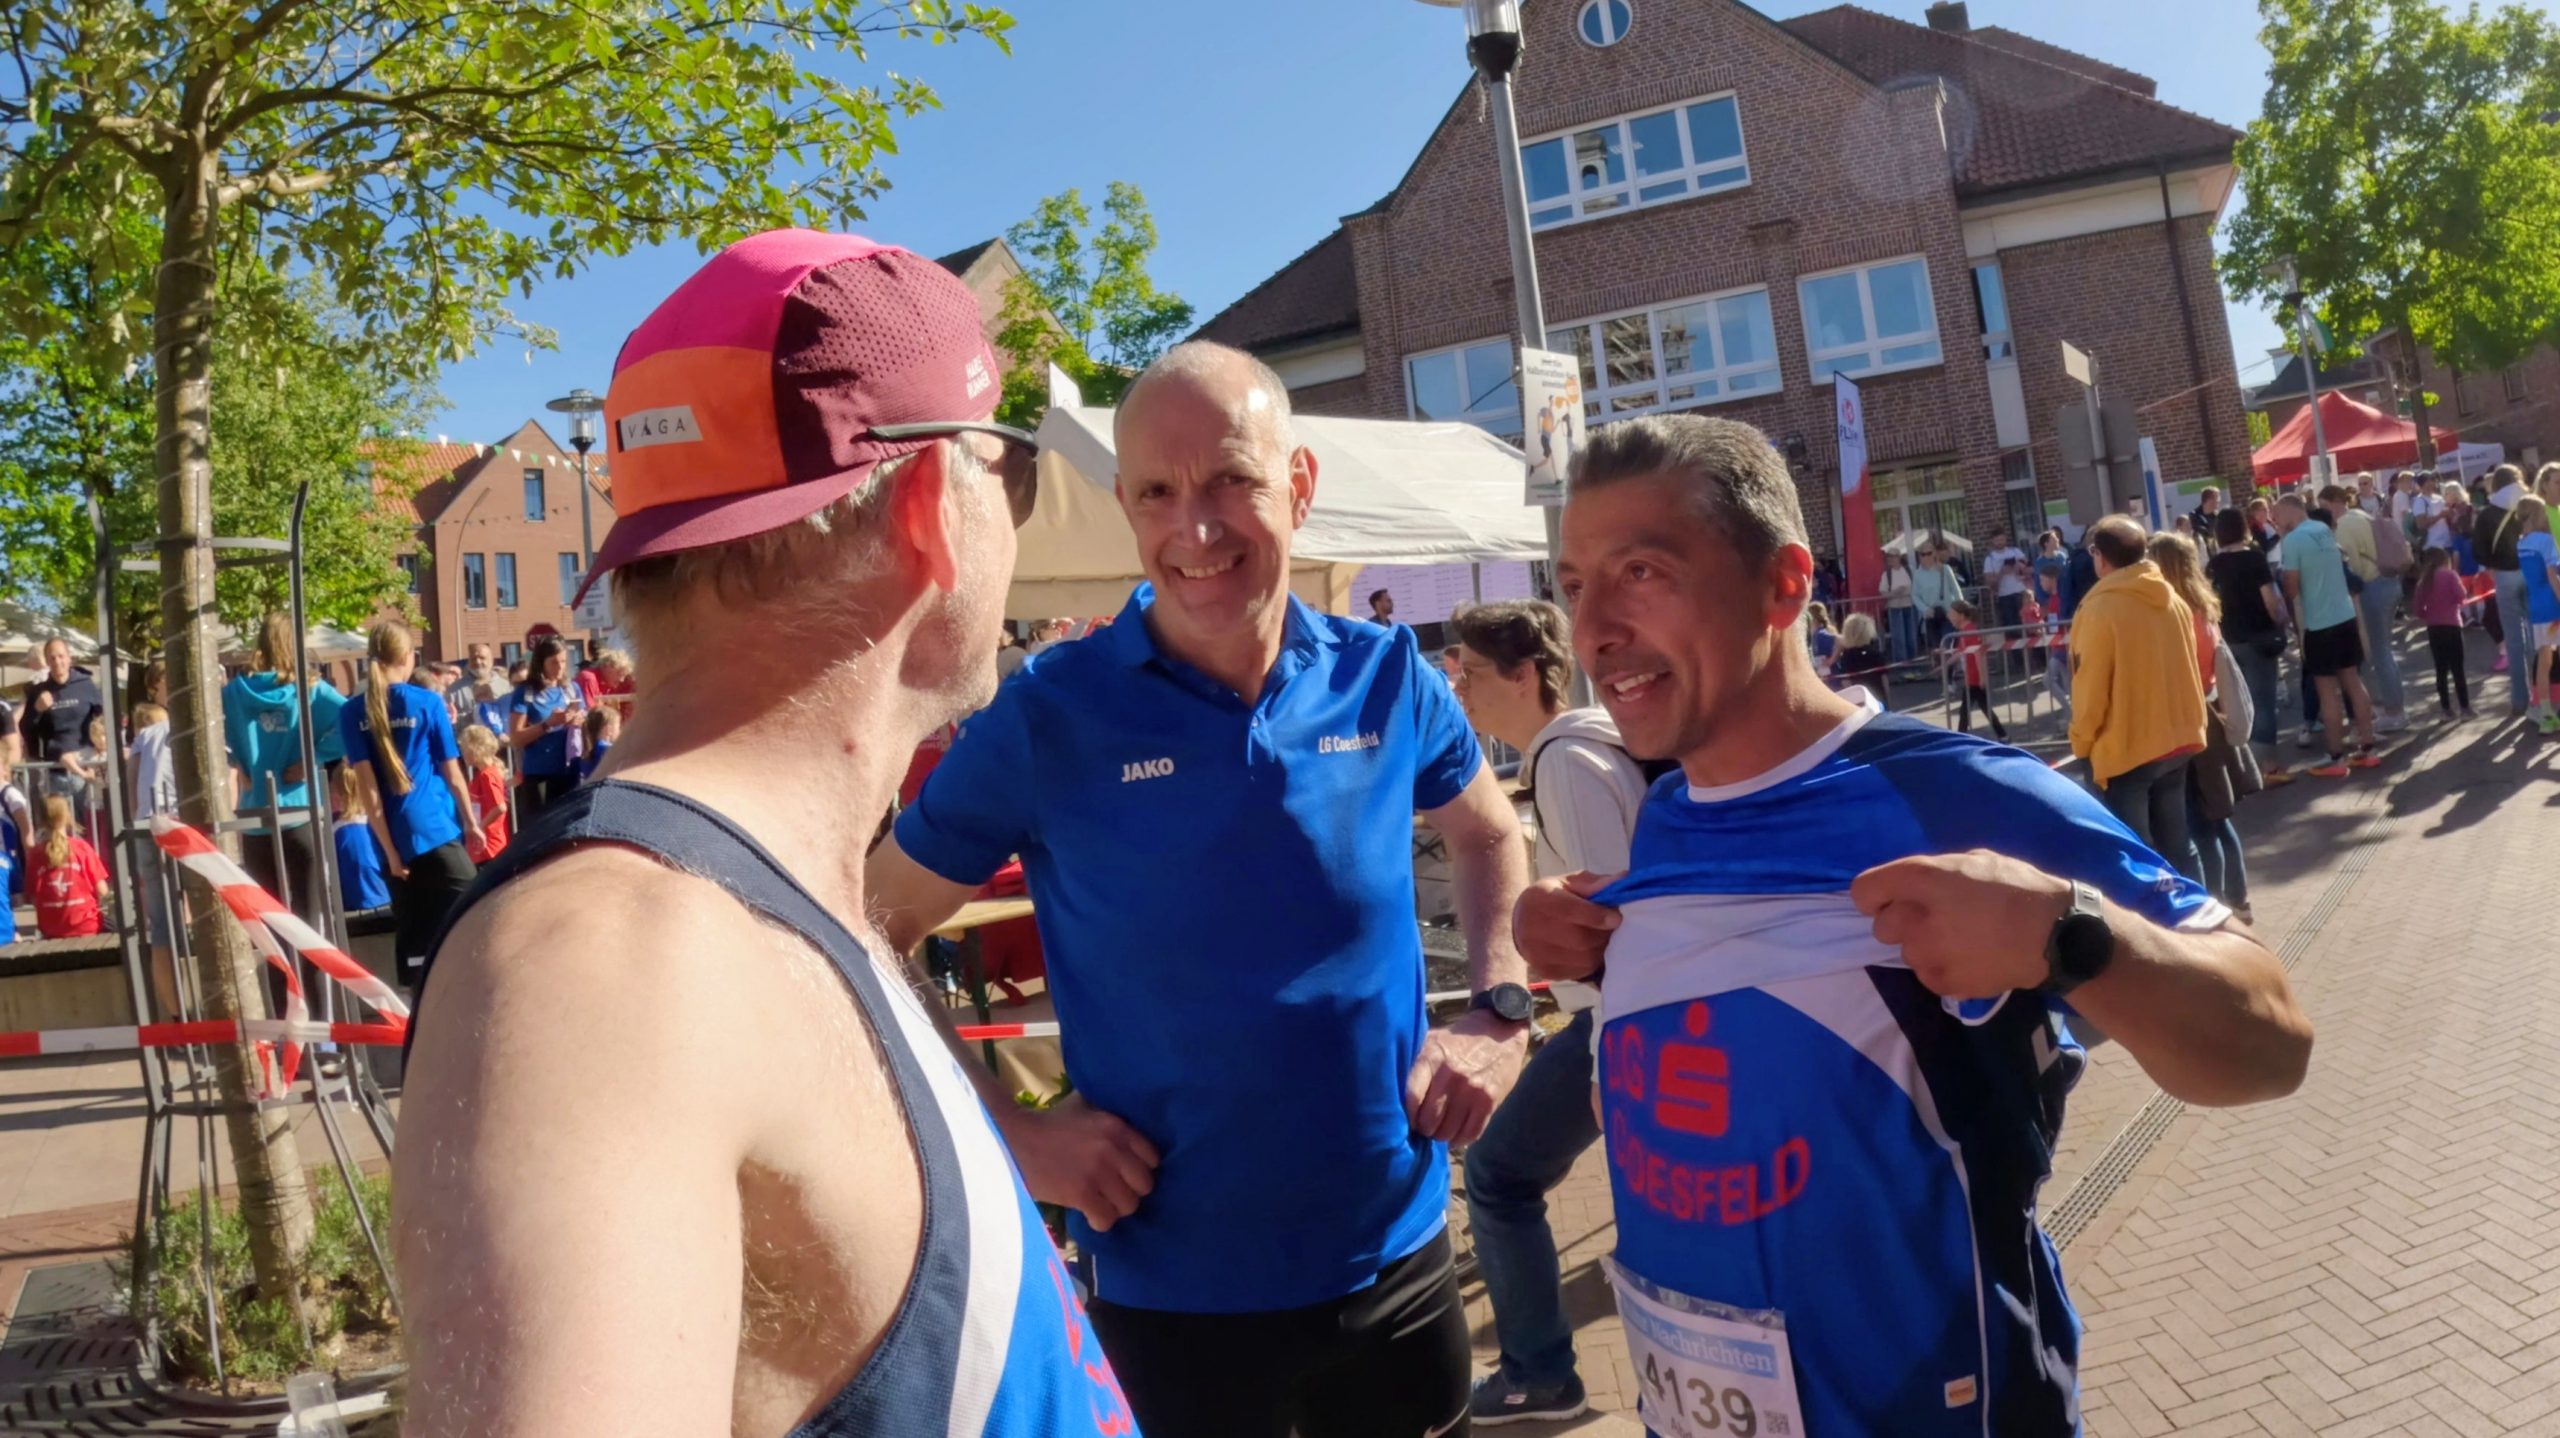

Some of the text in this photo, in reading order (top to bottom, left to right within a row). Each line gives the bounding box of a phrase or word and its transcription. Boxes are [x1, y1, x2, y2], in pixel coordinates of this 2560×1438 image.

[1121, 757, 1175, 783] JAKO
[1319, 731, 1379, 754] LG Coesfeld
[1604, 1023, 1646, 1101] LG
[1611, 1106, 1811, 1226] COESFELD
[1650, 1319, 1774, 1373] Nachrichten
[1645, 1352, 1757, 1438] 4139
